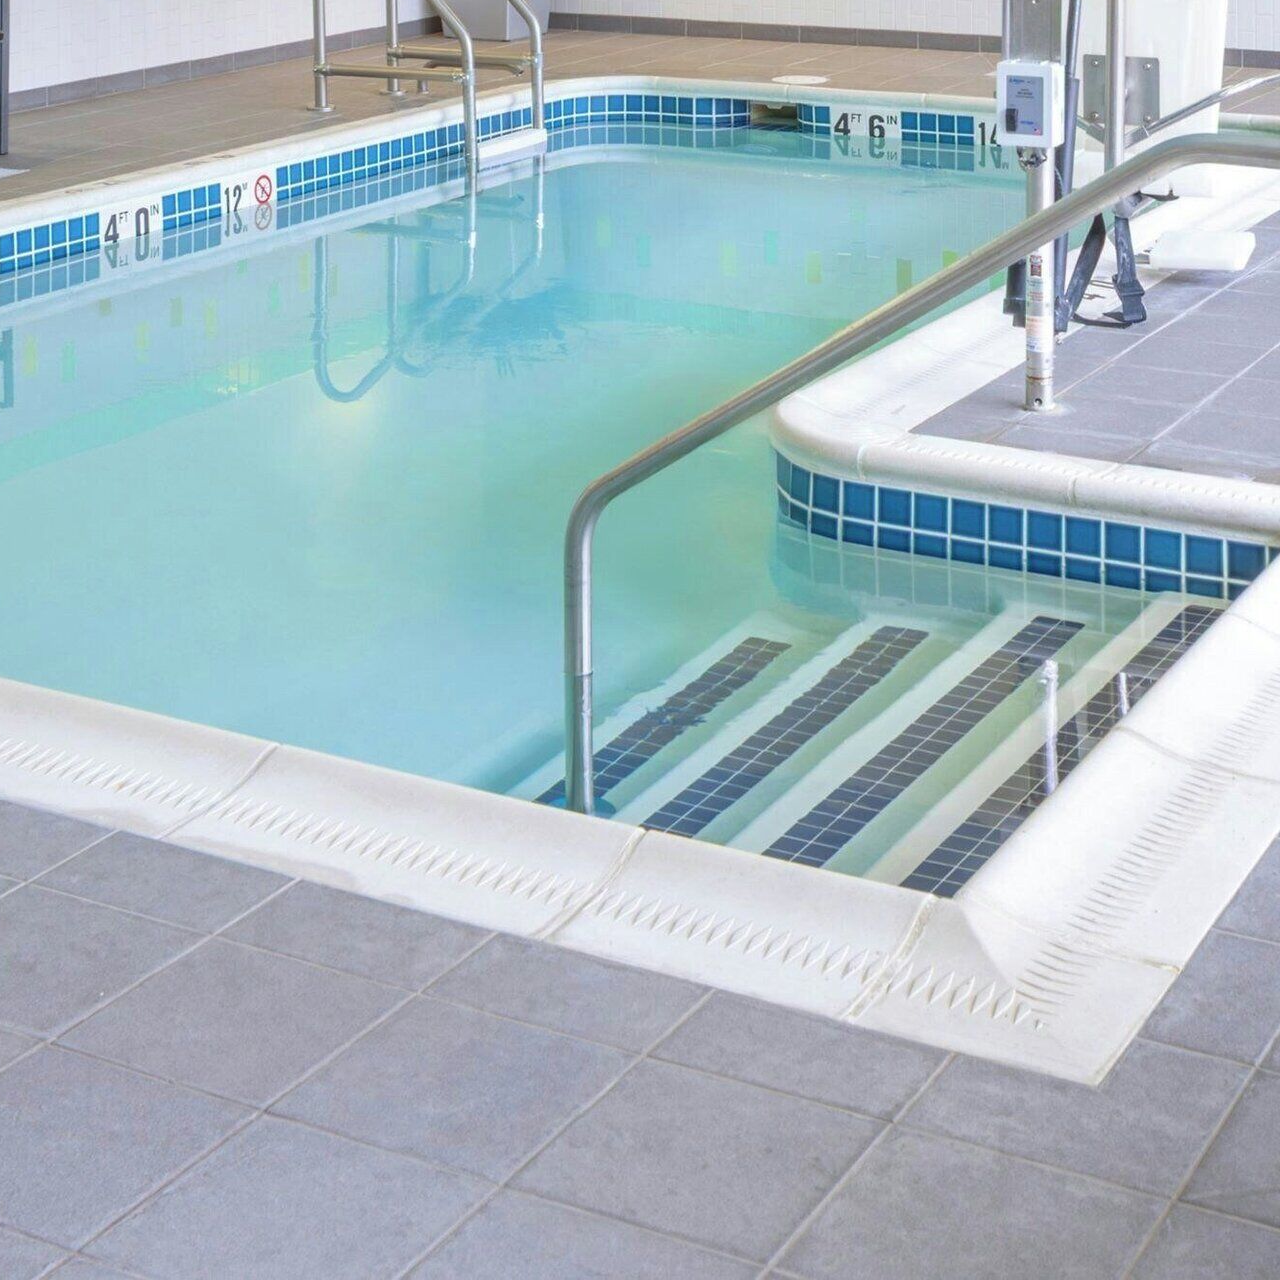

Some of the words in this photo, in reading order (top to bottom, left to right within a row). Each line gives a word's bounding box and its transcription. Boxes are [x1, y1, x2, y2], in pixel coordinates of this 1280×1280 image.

[834, 112, 851, 136] 4
[868, 114, 885, 139] 6
[104, 213, 120, 243] 4
[135, 206, 150, 237] 0
